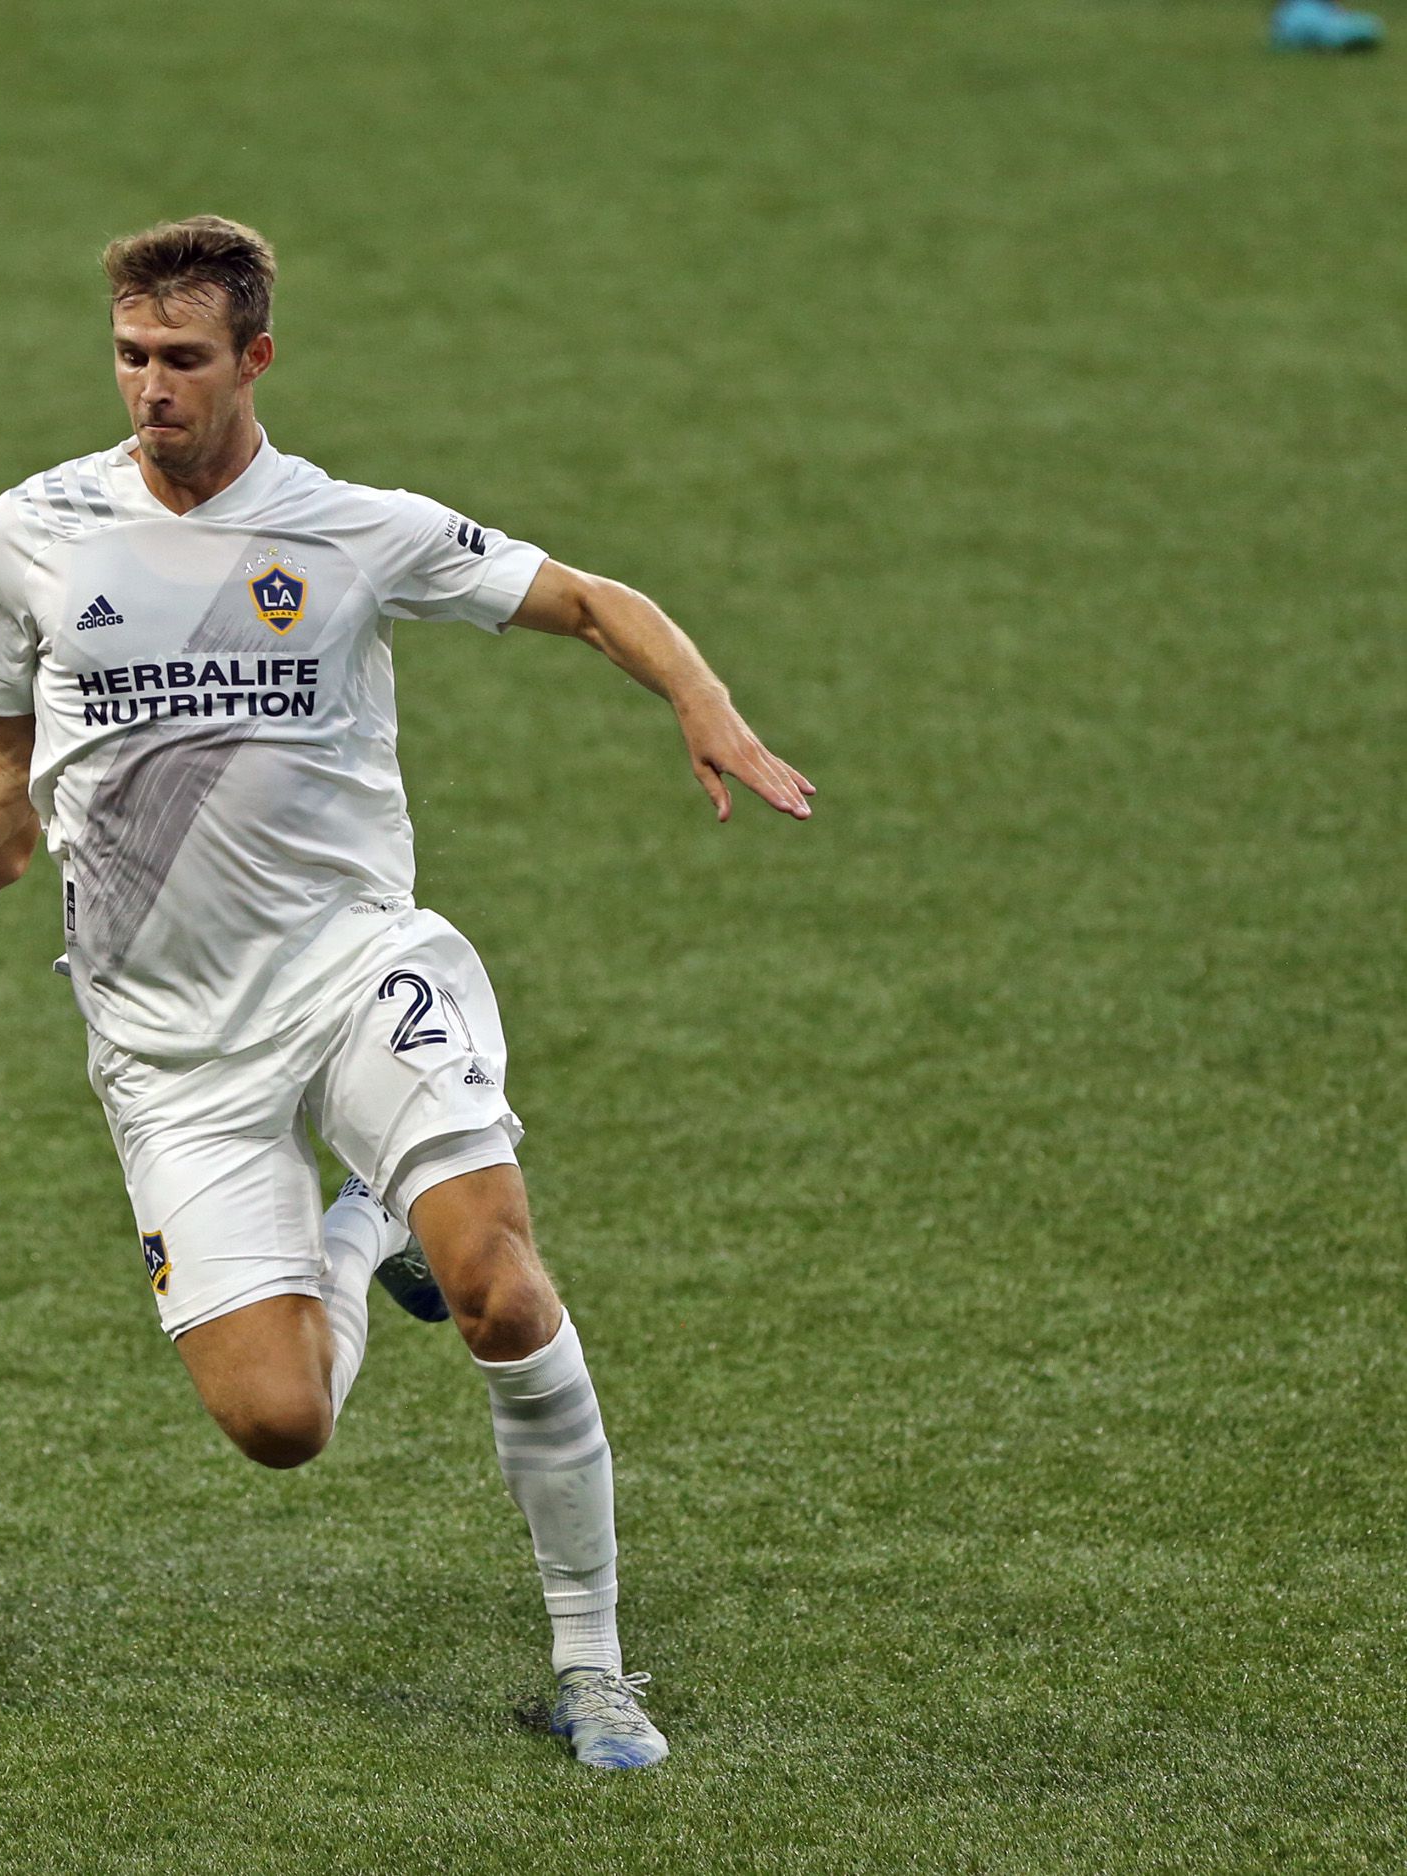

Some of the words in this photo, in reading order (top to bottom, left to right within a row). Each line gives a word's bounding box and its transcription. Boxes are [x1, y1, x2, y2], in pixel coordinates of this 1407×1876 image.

[262, 589, 296, 607] LA
[76, 614, 125, 631] adidas
[262, 610, 299, 618] GALAXY
[76, 658, 320, 697] HERBALIFE
[83, 691, 317, 727] NUTRITION
